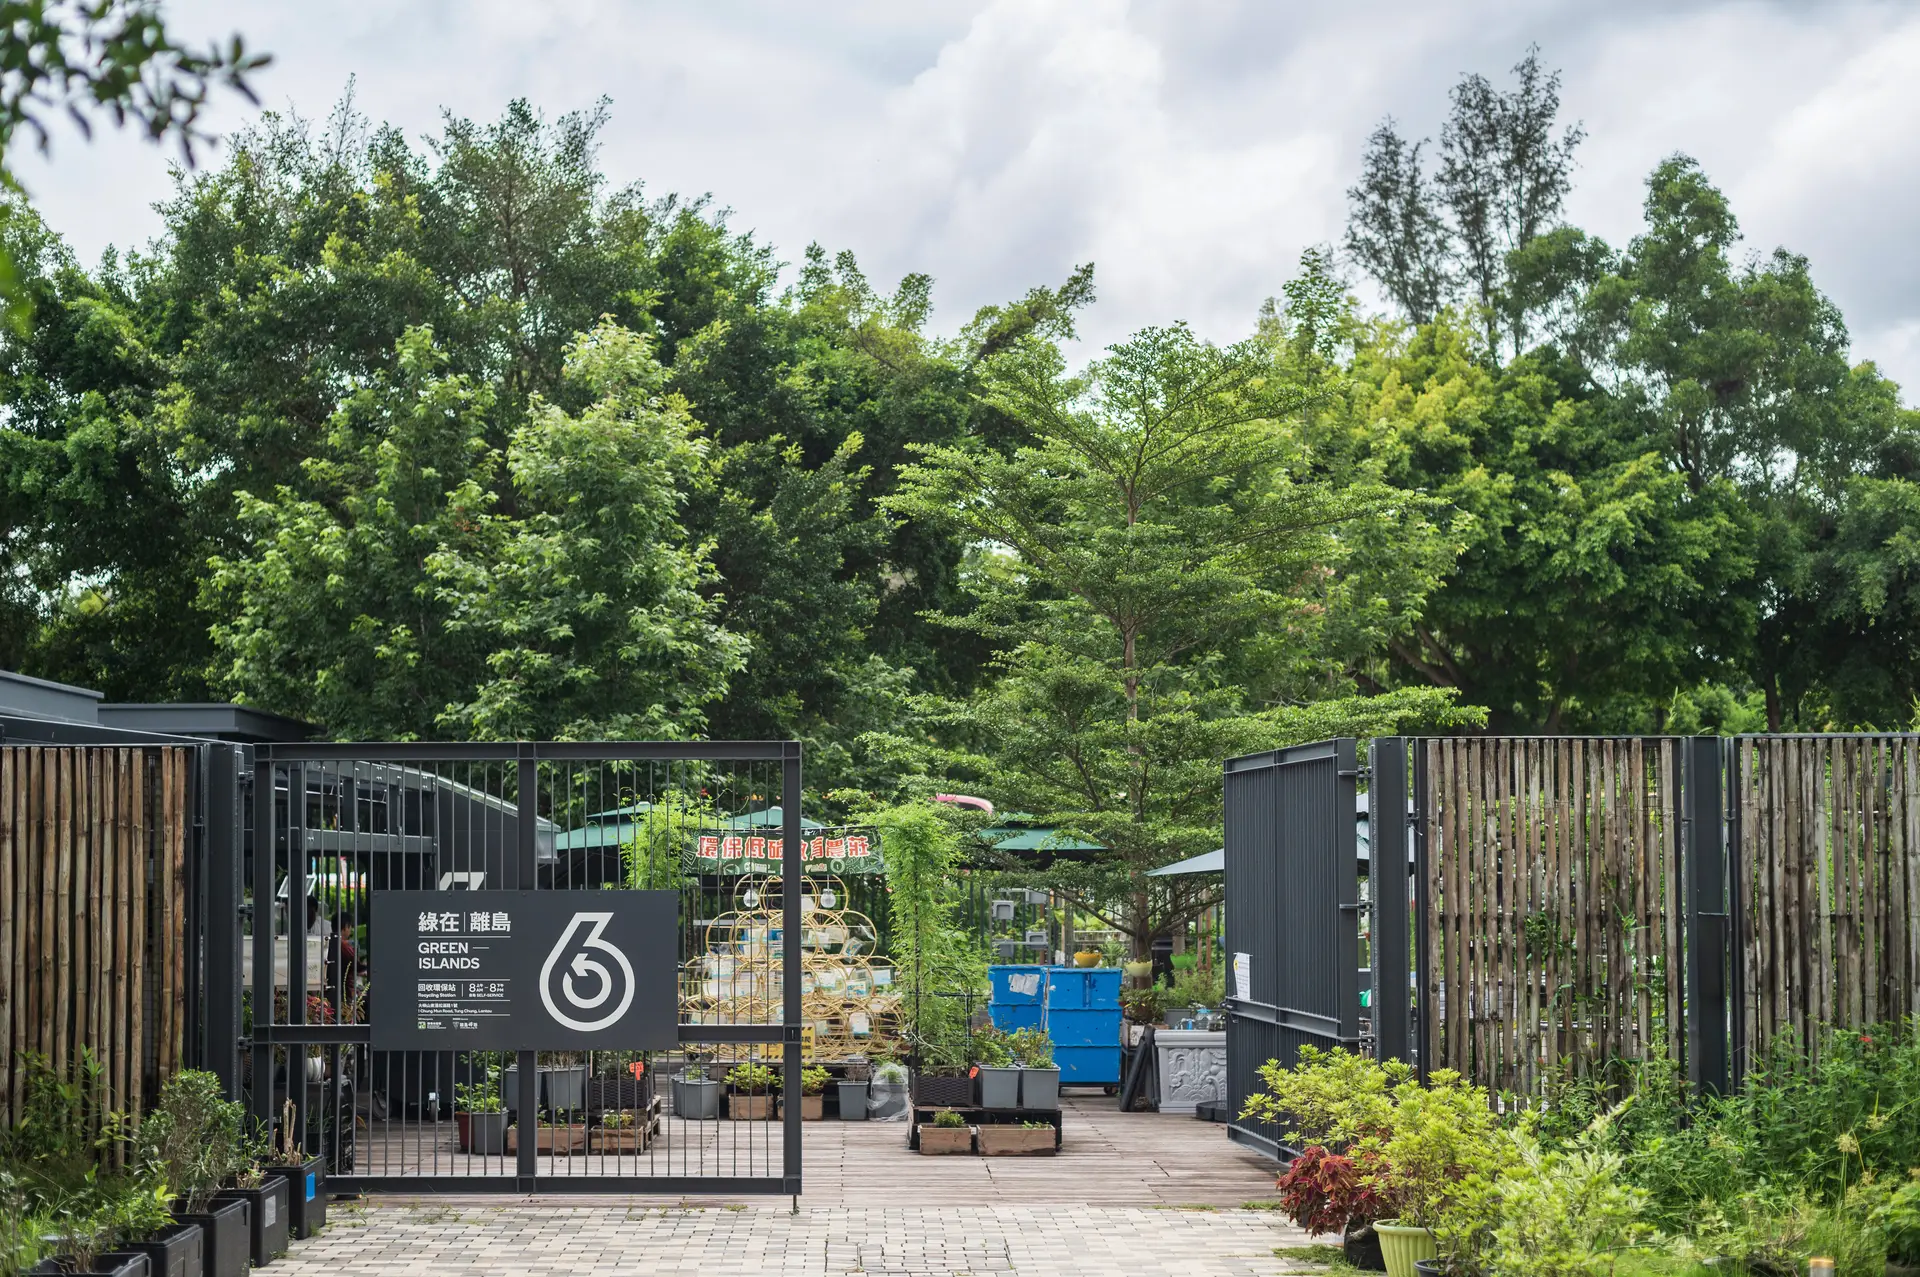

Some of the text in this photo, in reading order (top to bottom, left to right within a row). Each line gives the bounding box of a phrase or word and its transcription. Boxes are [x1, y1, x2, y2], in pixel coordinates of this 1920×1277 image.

[418, 912, 511, 932] 綠在 離島
[418, 942, 468, 954] GREEN
[418, 957, 480, 969] ISLANDS
[418, 983, 456, 992] 回收環保站
[468, 983, 476, 993] 8
[489, 983, 496, 993] 8
